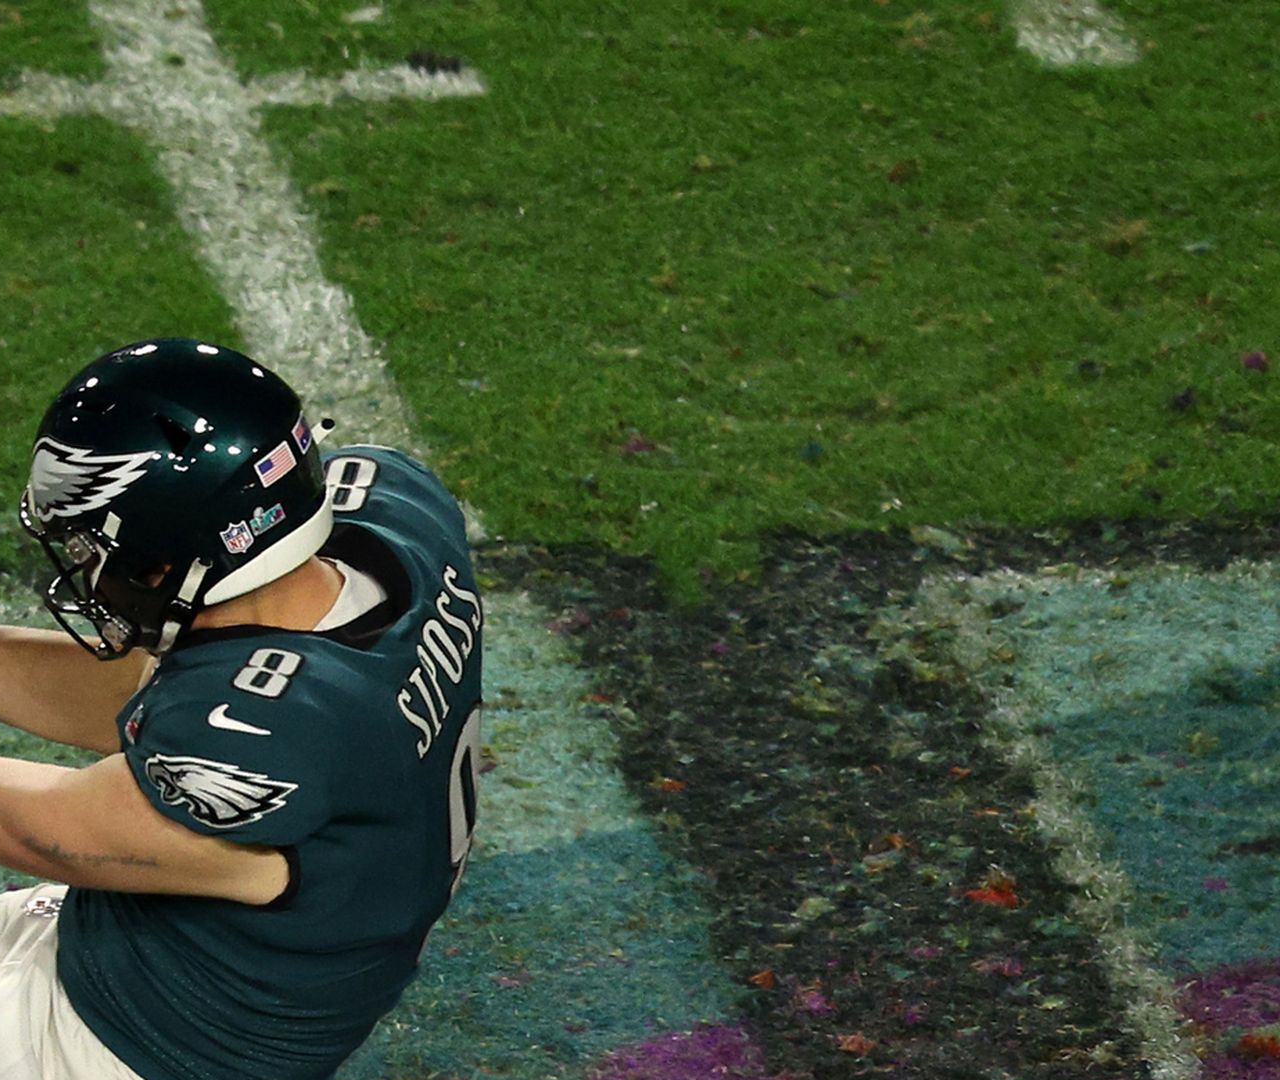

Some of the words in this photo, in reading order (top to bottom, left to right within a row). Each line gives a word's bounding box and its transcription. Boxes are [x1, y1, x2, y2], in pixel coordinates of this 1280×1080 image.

[325, 455, 378, 511] 8
[233, 648, 302, 697] 8
[396, 564, 483, 759] SIPOSS
